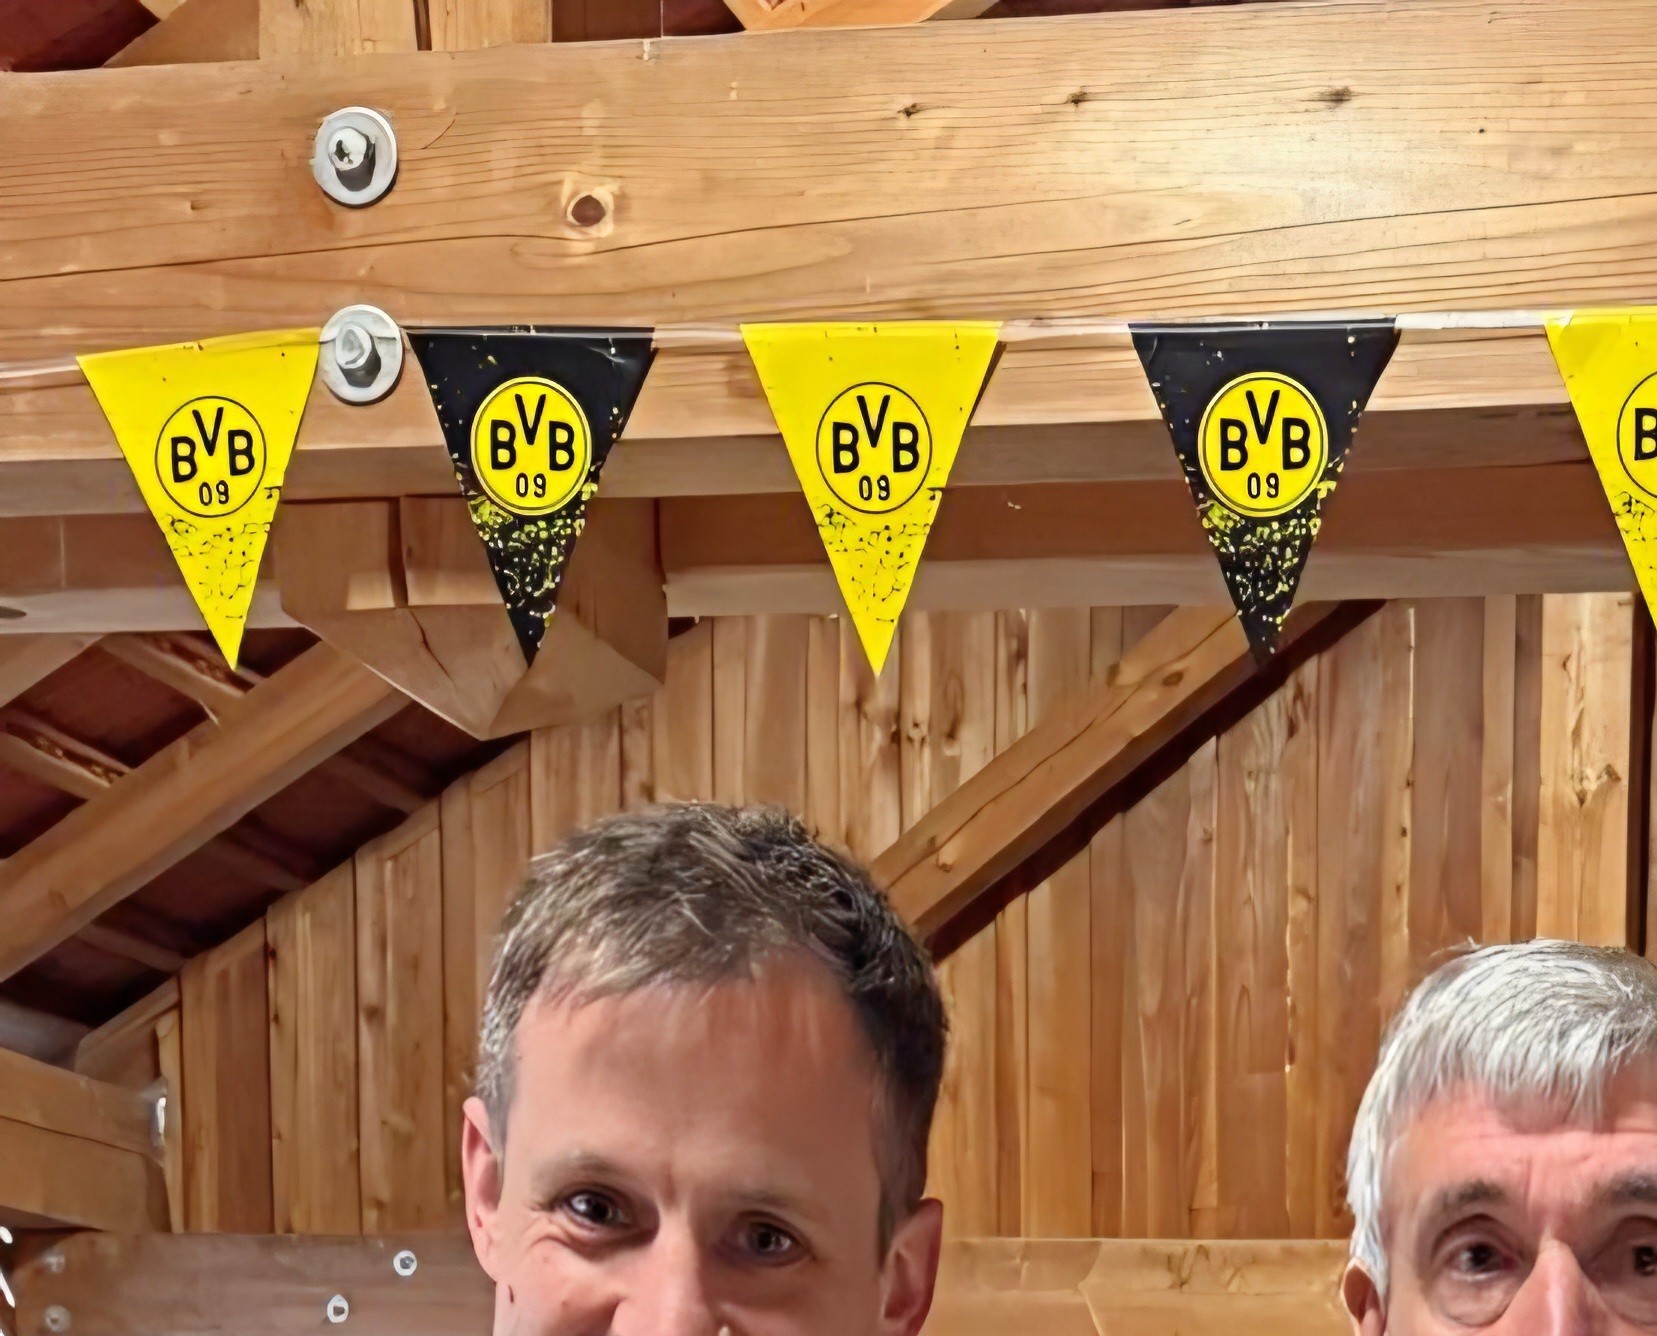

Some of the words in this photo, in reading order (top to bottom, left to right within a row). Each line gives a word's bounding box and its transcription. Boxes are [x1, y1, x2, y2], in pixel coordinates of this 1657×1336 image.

[171, 407, 255, 482] BVB
[491, 394, 574, 471] BVB
[833, 395, 919, 473] BVB
[1220, 390, 1310, 471] BVB
[199, 480, 229, 506] 09
[515, 473, 546, 498] 09
[859, 475, 890, 500] 09
[1248, 473, 1279, 498] 09
